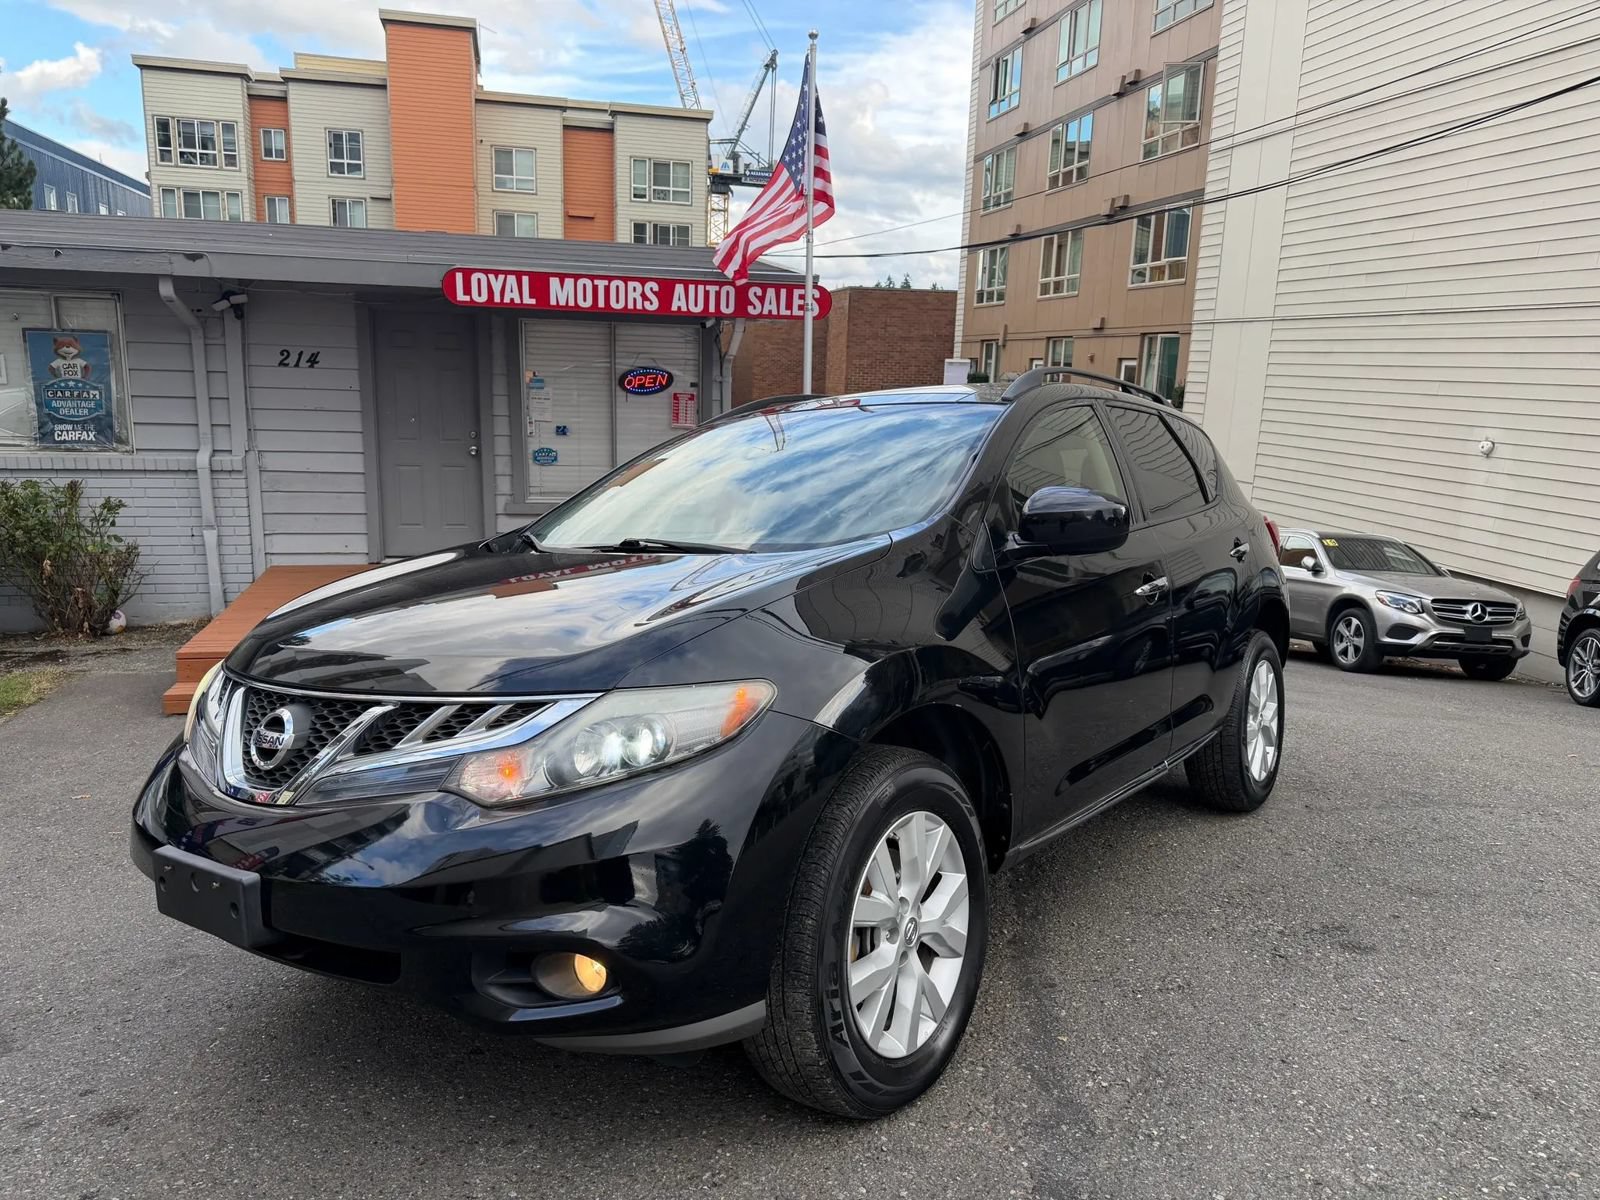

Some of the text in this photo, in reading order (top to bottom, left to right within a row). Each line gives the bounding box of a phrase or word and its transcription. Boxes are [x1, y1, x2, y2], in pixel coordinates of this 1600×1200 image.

[455, 272, 821, 318] LOYAL MOTORS AUTO SALES
[278, 349, 321, 369] 214
[624, 374, 668, 389] OPEN
[47, 390, 100, 400] CARFAX
[51, 400, 96, 408] ADVANTAGE
[59, 408, 89, 416] DEALER
[54, 431, 96, 441] CARFAX
[254, 733, 285, 746] SSAN
